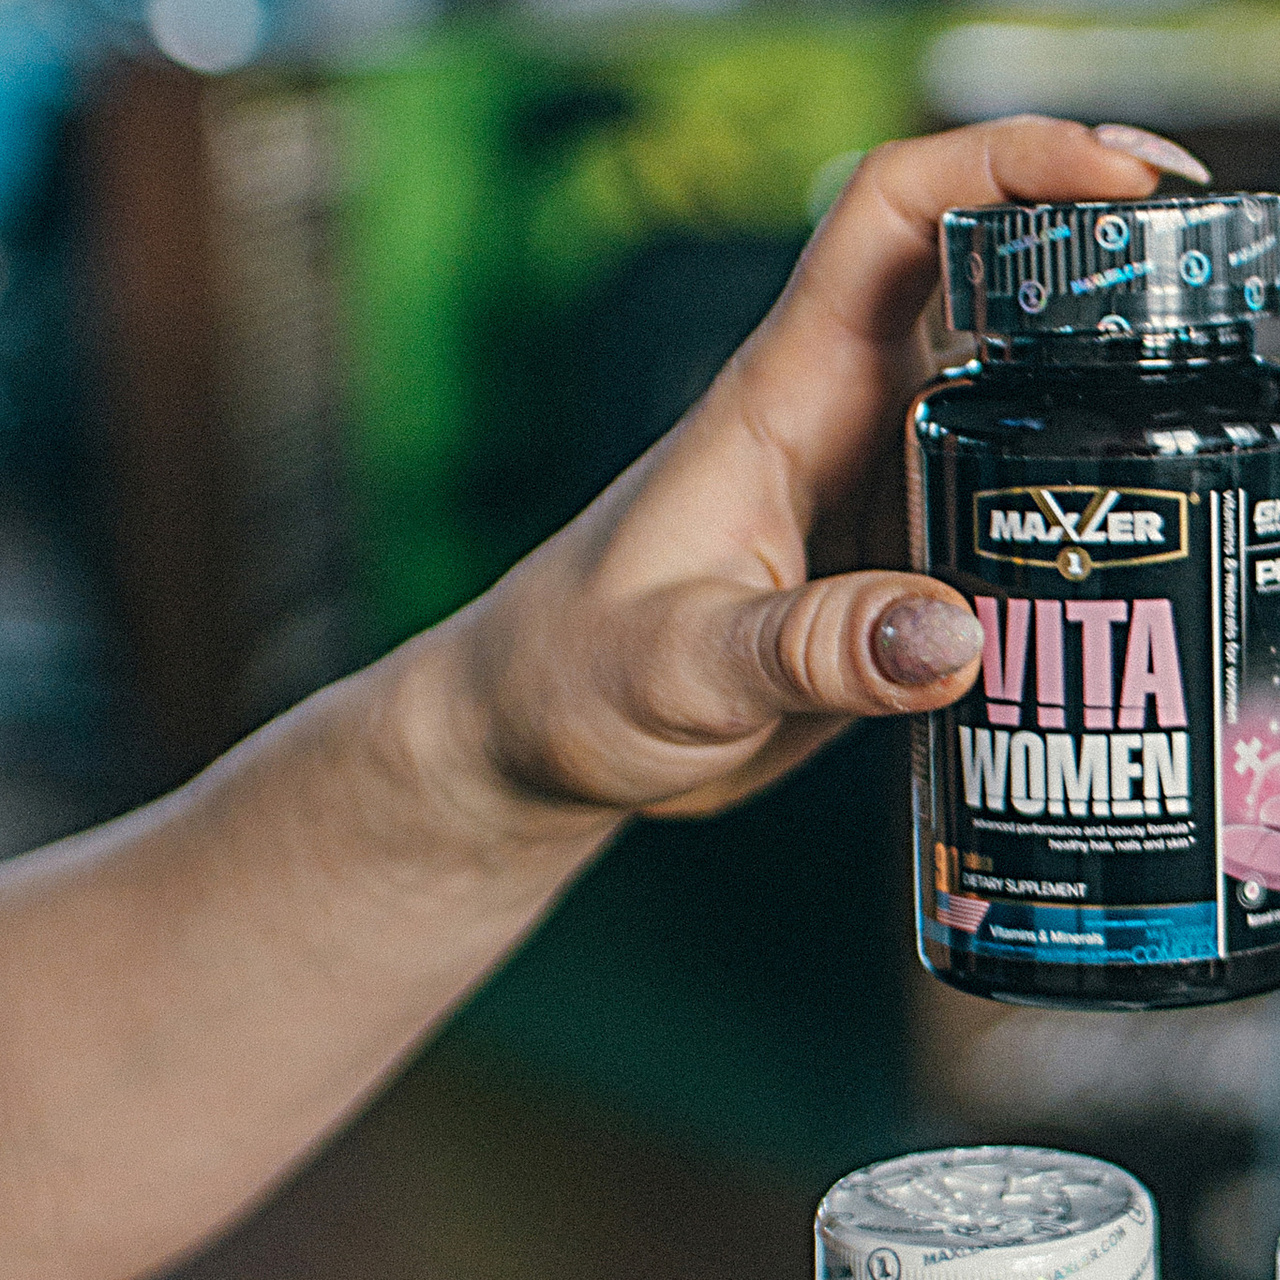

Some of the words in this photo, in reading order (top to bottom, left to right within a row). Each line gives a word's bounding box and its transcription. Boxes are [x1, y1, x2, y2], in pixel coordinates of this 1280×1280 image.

[989, 489, 1166, 544] MAXLER
[974, 596, 1189, 730] VITA
[958, 724, 1191, 818] WOMEN
